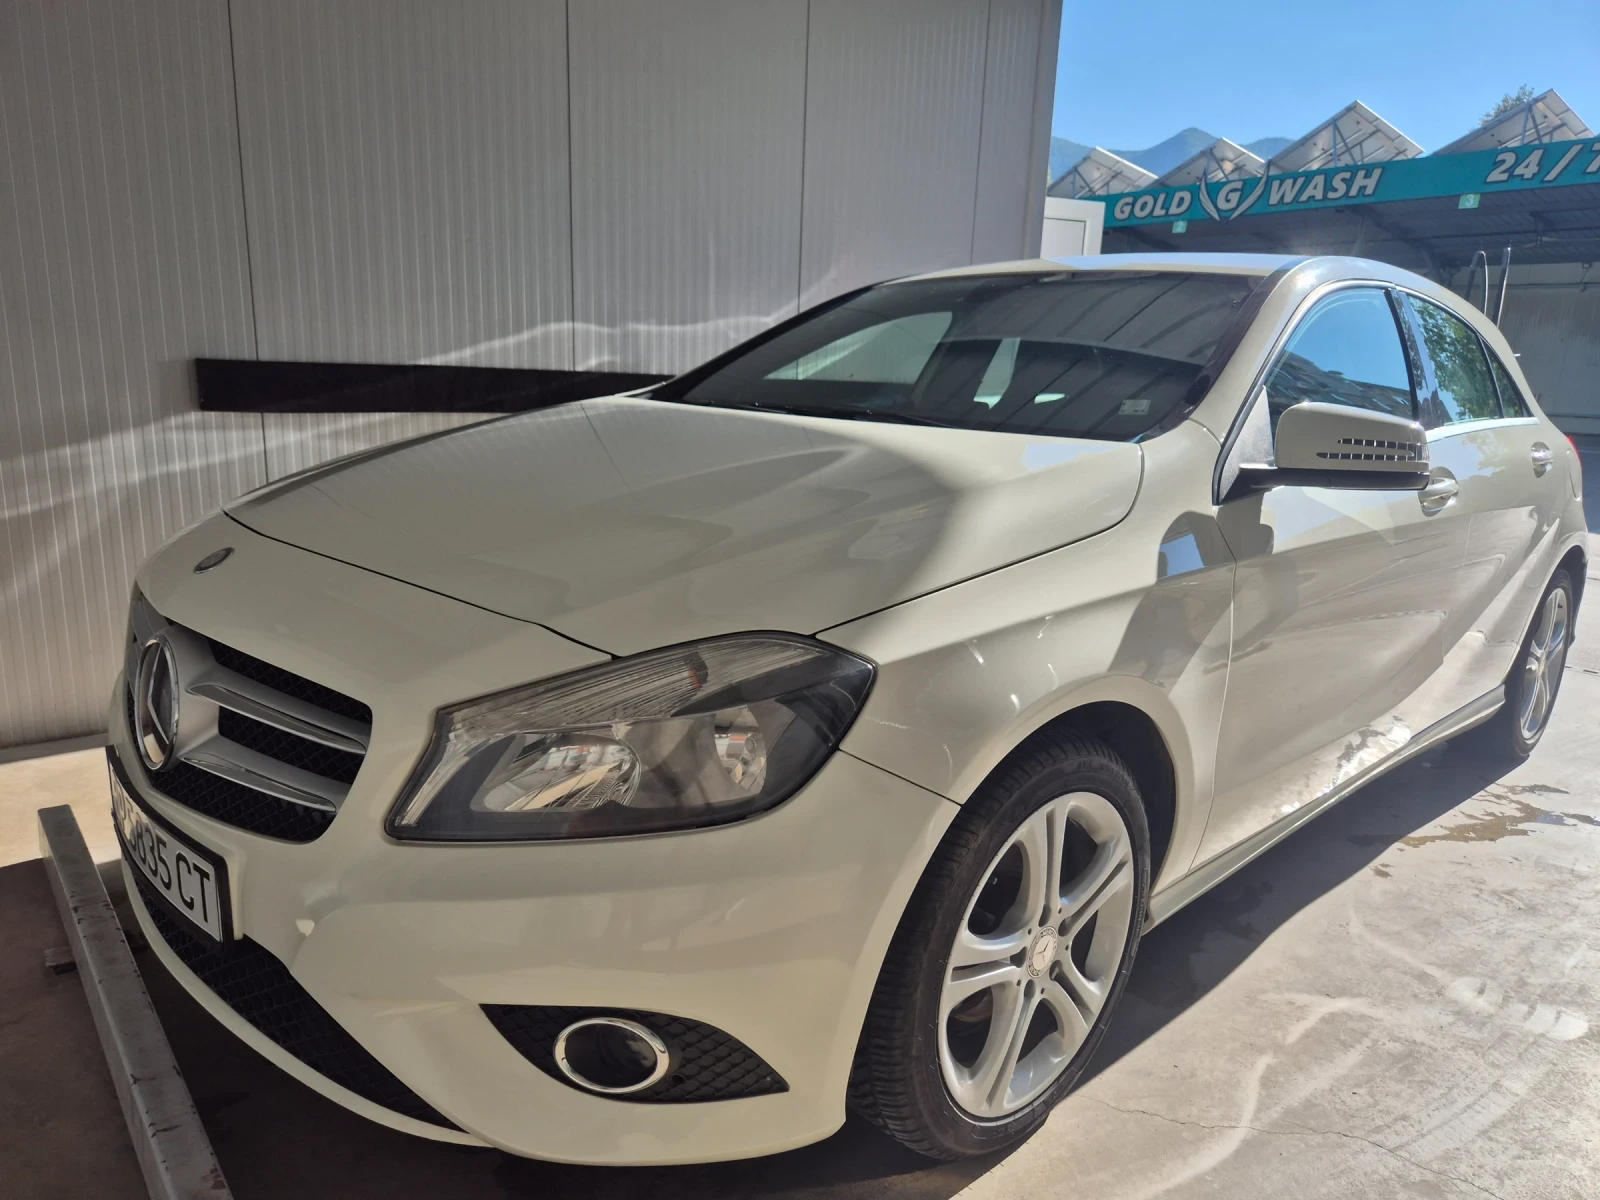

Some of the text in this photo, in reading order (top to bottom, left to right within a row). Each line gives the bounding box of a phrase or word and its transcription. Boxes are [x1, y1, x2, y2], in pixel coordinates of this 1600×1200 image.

[1113, 168, 1383, 221] GOLD G WASH
[1465, 193, 1475, 207] 3
[175, 851, 211, 924] CT
